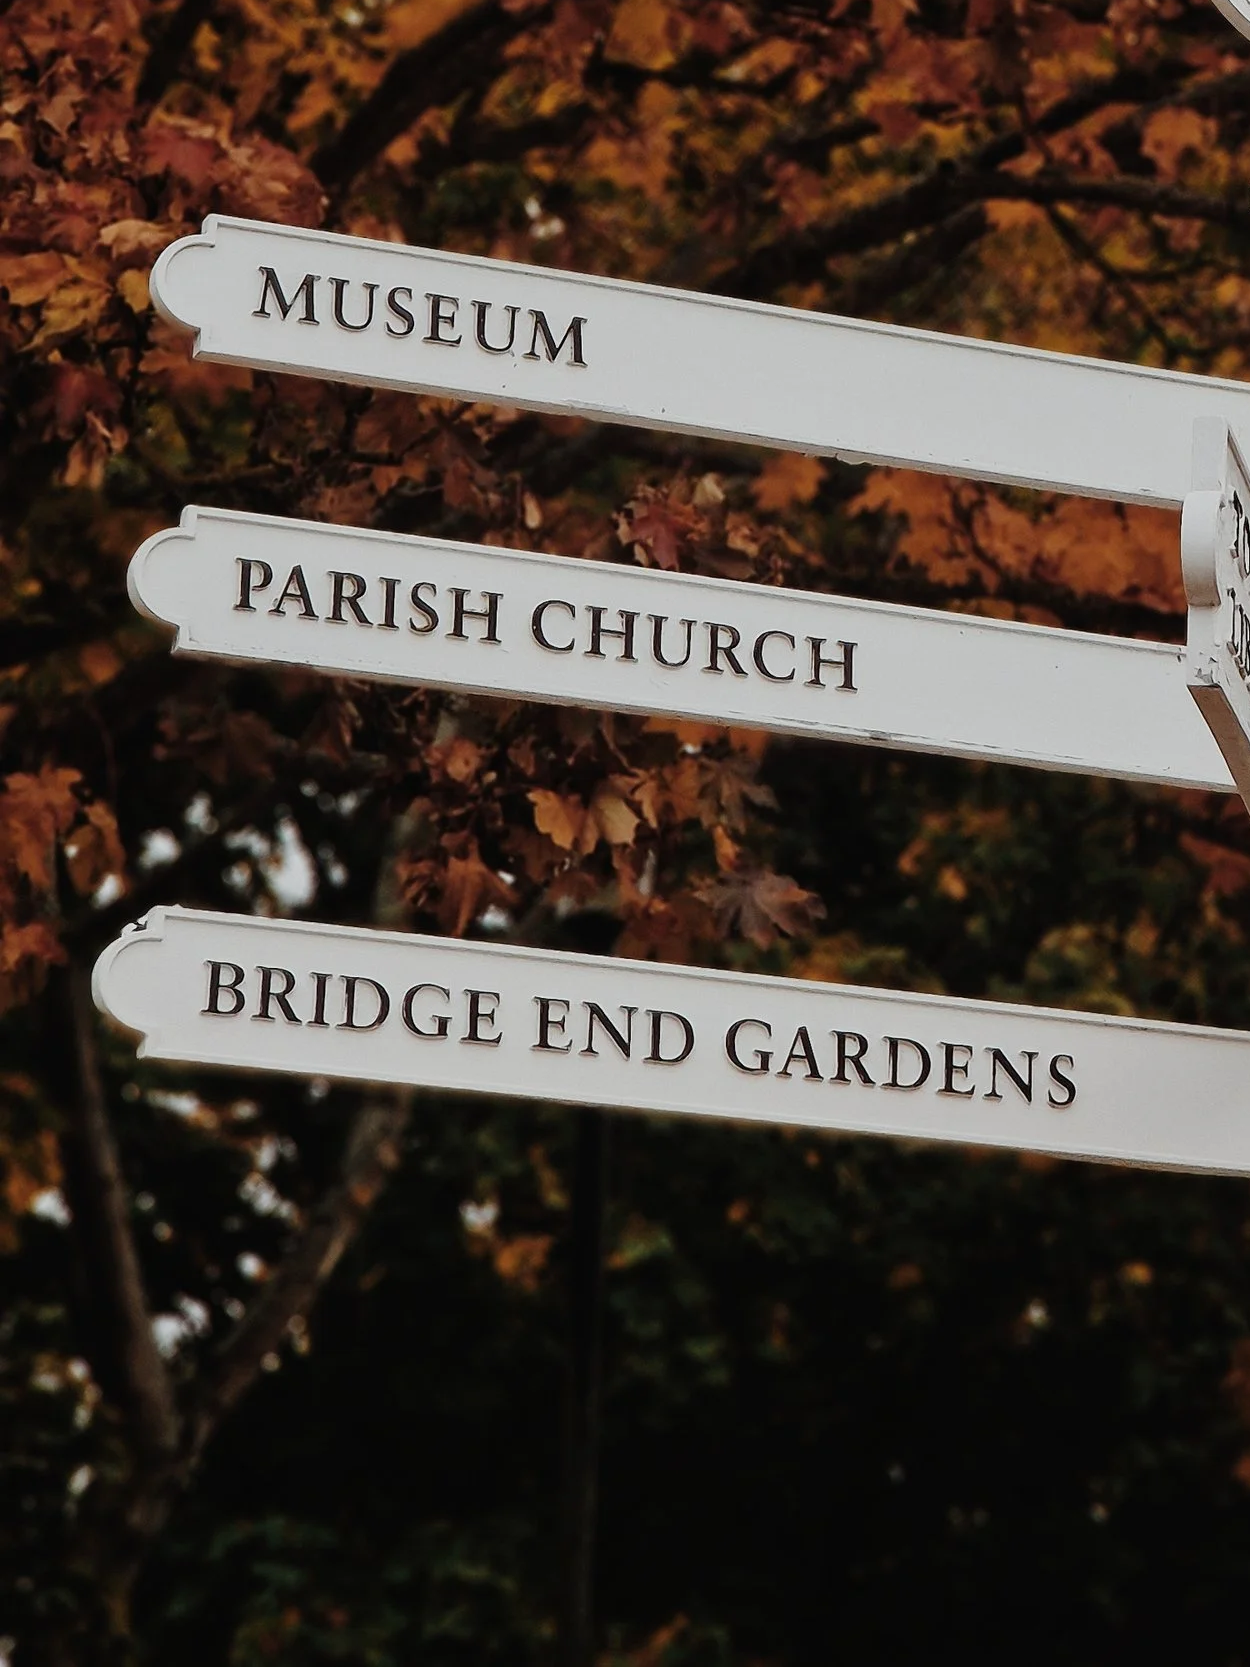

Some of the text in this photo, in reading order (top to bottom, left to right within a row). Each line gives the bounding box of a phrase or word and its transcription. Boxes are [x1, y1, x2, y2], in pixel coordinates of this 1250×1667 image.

[252, 265, 589, 367] MUSEUM
[233, 556, 859, 692] PARISH CHURCH
[202, 959, 1078, 1109] BRIDGE END GARDENS
